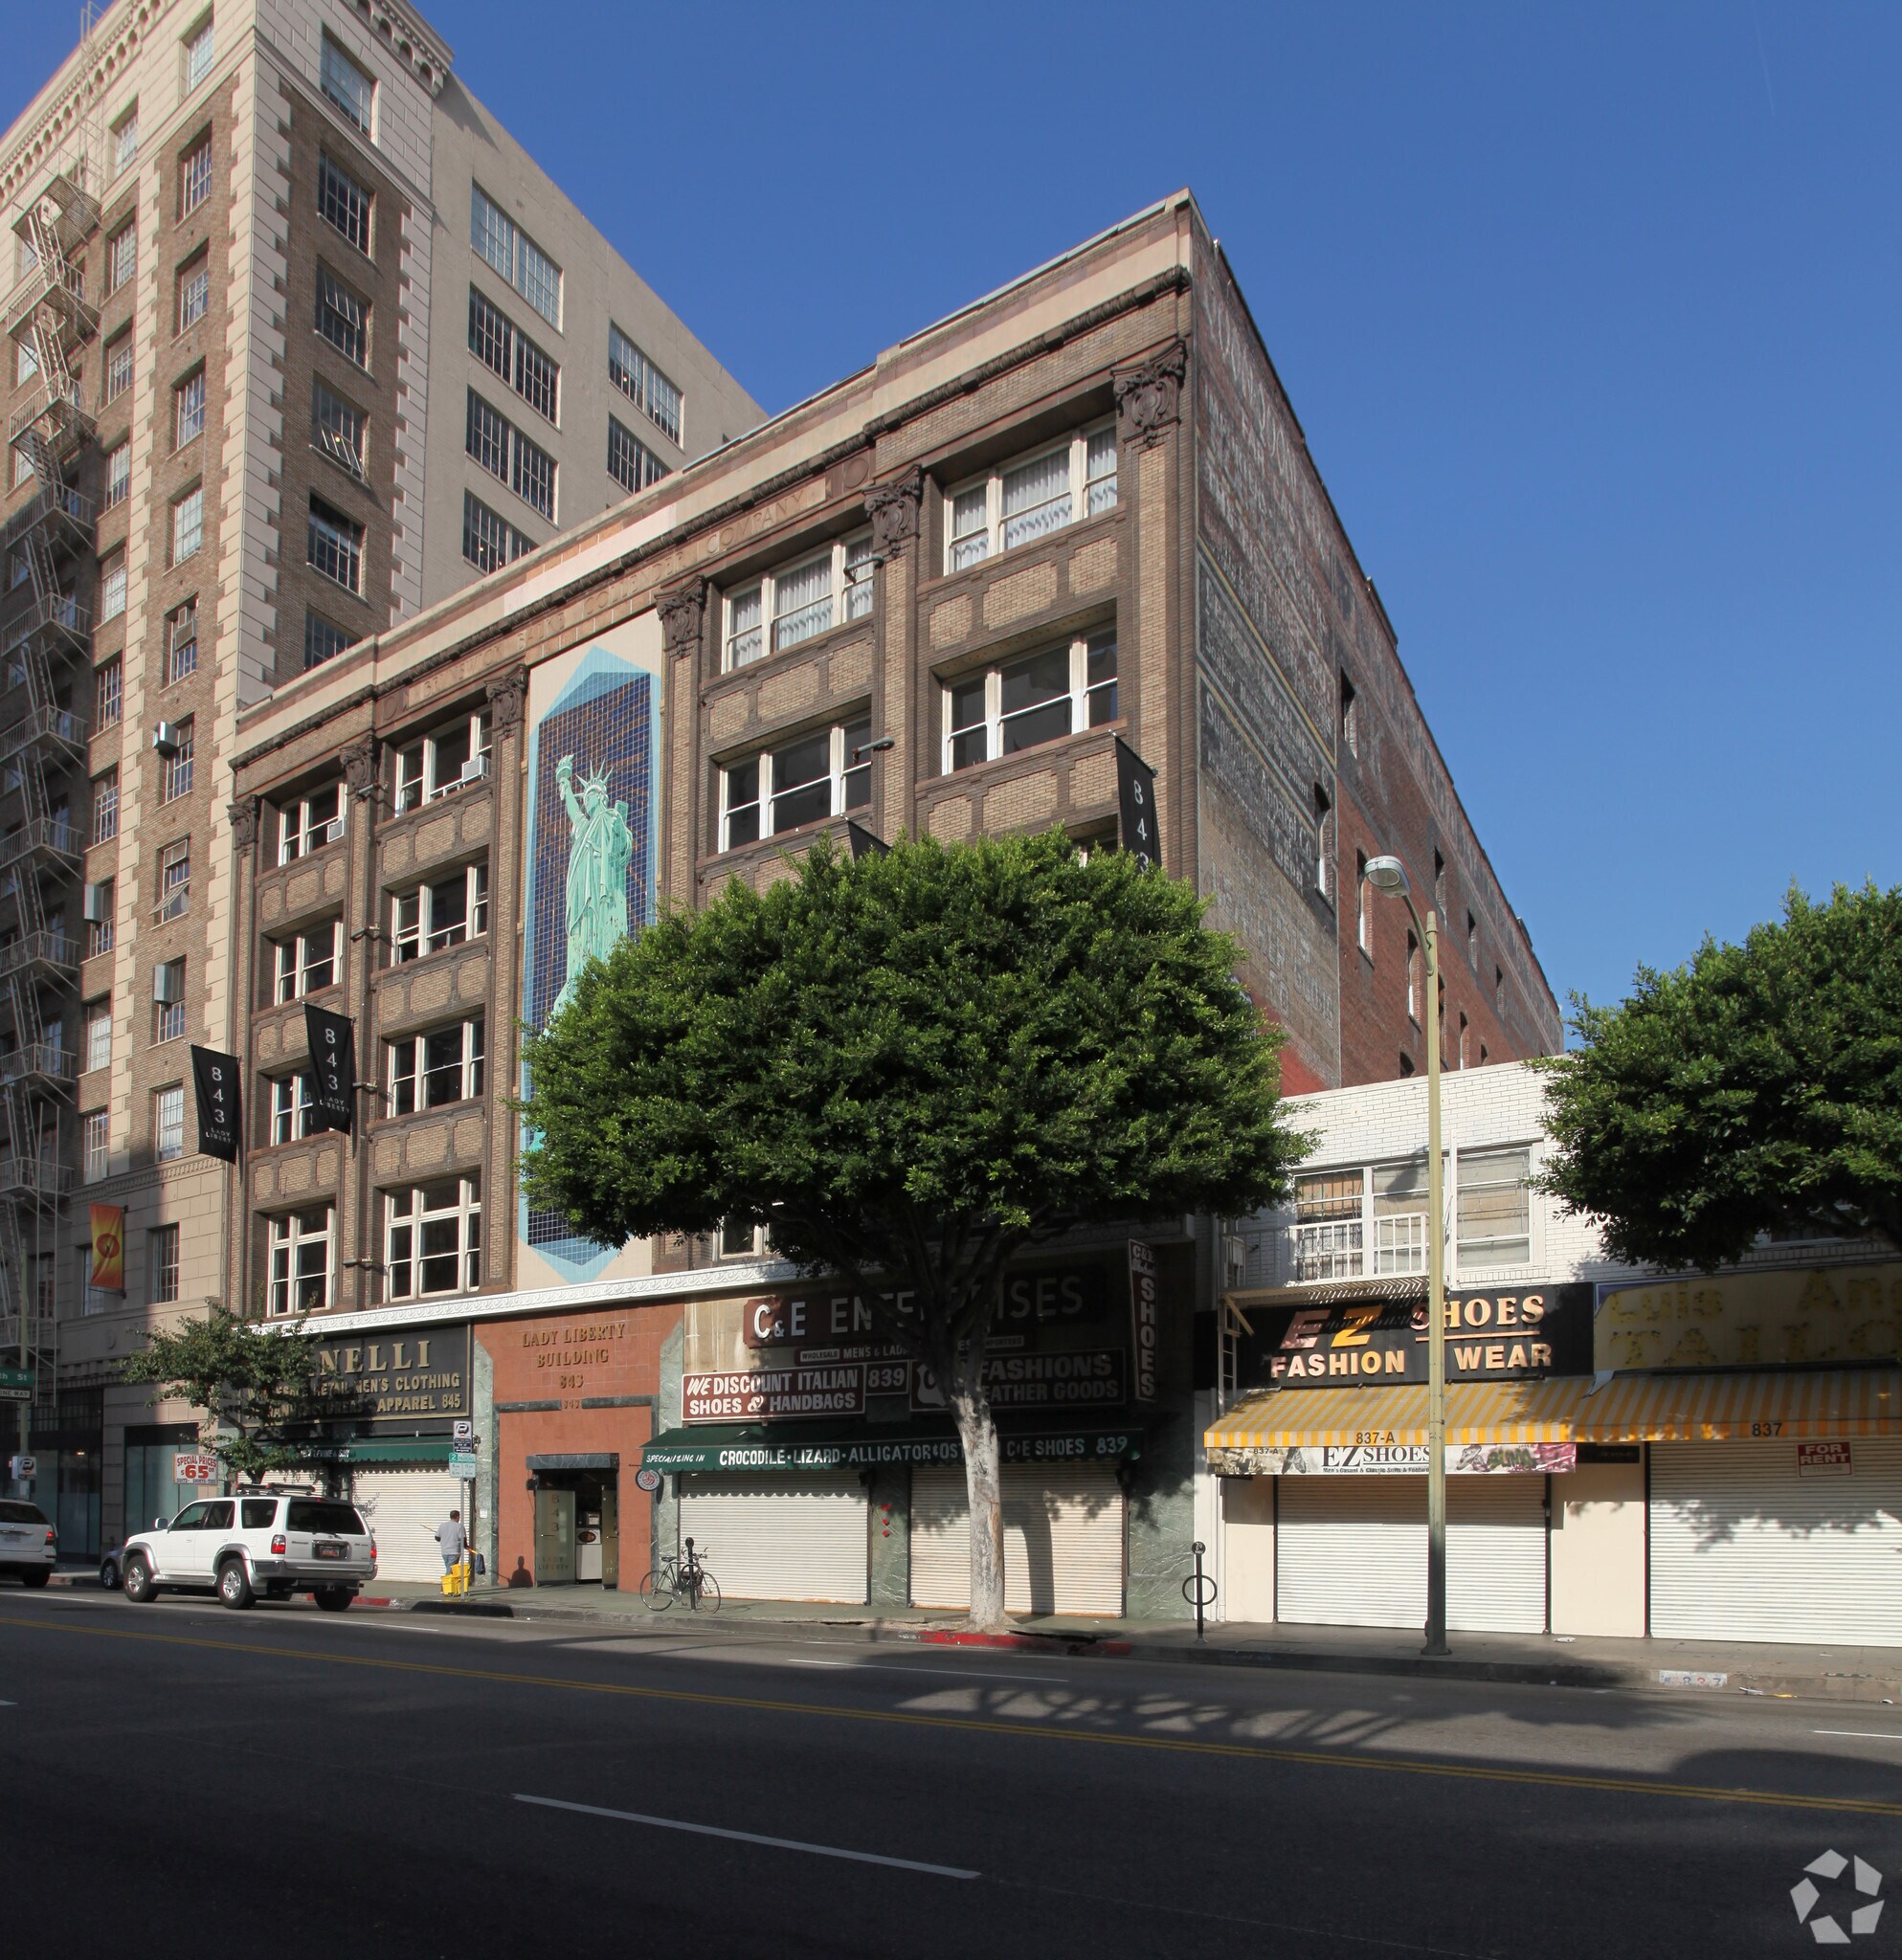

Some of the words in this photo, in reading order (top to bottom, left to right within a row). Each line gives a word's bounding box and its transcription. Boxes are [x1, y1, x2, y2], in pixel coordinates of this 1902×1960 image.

[706, 489, 805, 554] COMPANY
[324, 1028, 338, 1090] 843
[211, 1066, 225, 1124] 843
[831, 1276, 1084, 1334] ENEISES
[1280, 1303, 1384, 1349] EZ
[1410, 1295, 1545, 1331] SHOES
[523, 1330, 558, 1348] LADY
[564, 1324, 625, 1343] LIBERTY
[1140, 1277, 1156, 1396] SHOES
[537, 1348, 609, 1368] BUILDING
[1271, 1350, 1405, 1379] FASHION
[1454, 1343, 1553, 1371] WEAR
[17, 1372, 28, 1381] St
[395, 1372, 460, 1392] CLOTHING
[686, 1377, 712, 1396] WE
[713, 1372, 793, 1395] DISCOUNT
[797, 1369, 858, 1391] ITALIAN
[868, 1368, 905, 1387] 839
[982, 1382, 1047, 1403] EATHER
[1054, 1380, 1119, 1400] GOODS
[377, 1395, 436, 1413] APPAREL
[442, 1393, 460, 1409] 845
[689, 1396, 742, 1415] SHOES
[770, 1392, 857, 1413] HANDBAGS
[1355, 1432, 1395, 1444] 837-A
[1752, 1422, 1783, 1437] 837
[720, 1448, 786, 1465] CROCODILE
[794, 1448, 840, 1464] LIZARD
[848, 1444, 931, 1462] ALLIGATOR
[1035, 1437, 1085, 1456] SHOES
[1096, 1436, 1128, 1454] 839
[1322, 1446, 1360, 1466] EZ
[1363, 1446, 1429, 1462] SHOES
[1805, 1443, 1843, 1455] FOR
[177, 1455, 197, 1466] SPECIAL
[199, 1456, 216, 1467] PRICES
[645, 1454, 694, 1464] SPECIALIZING
[696, 1454, 705, 1462] IN
[1801, 1453, 1848, 1464] RENT
